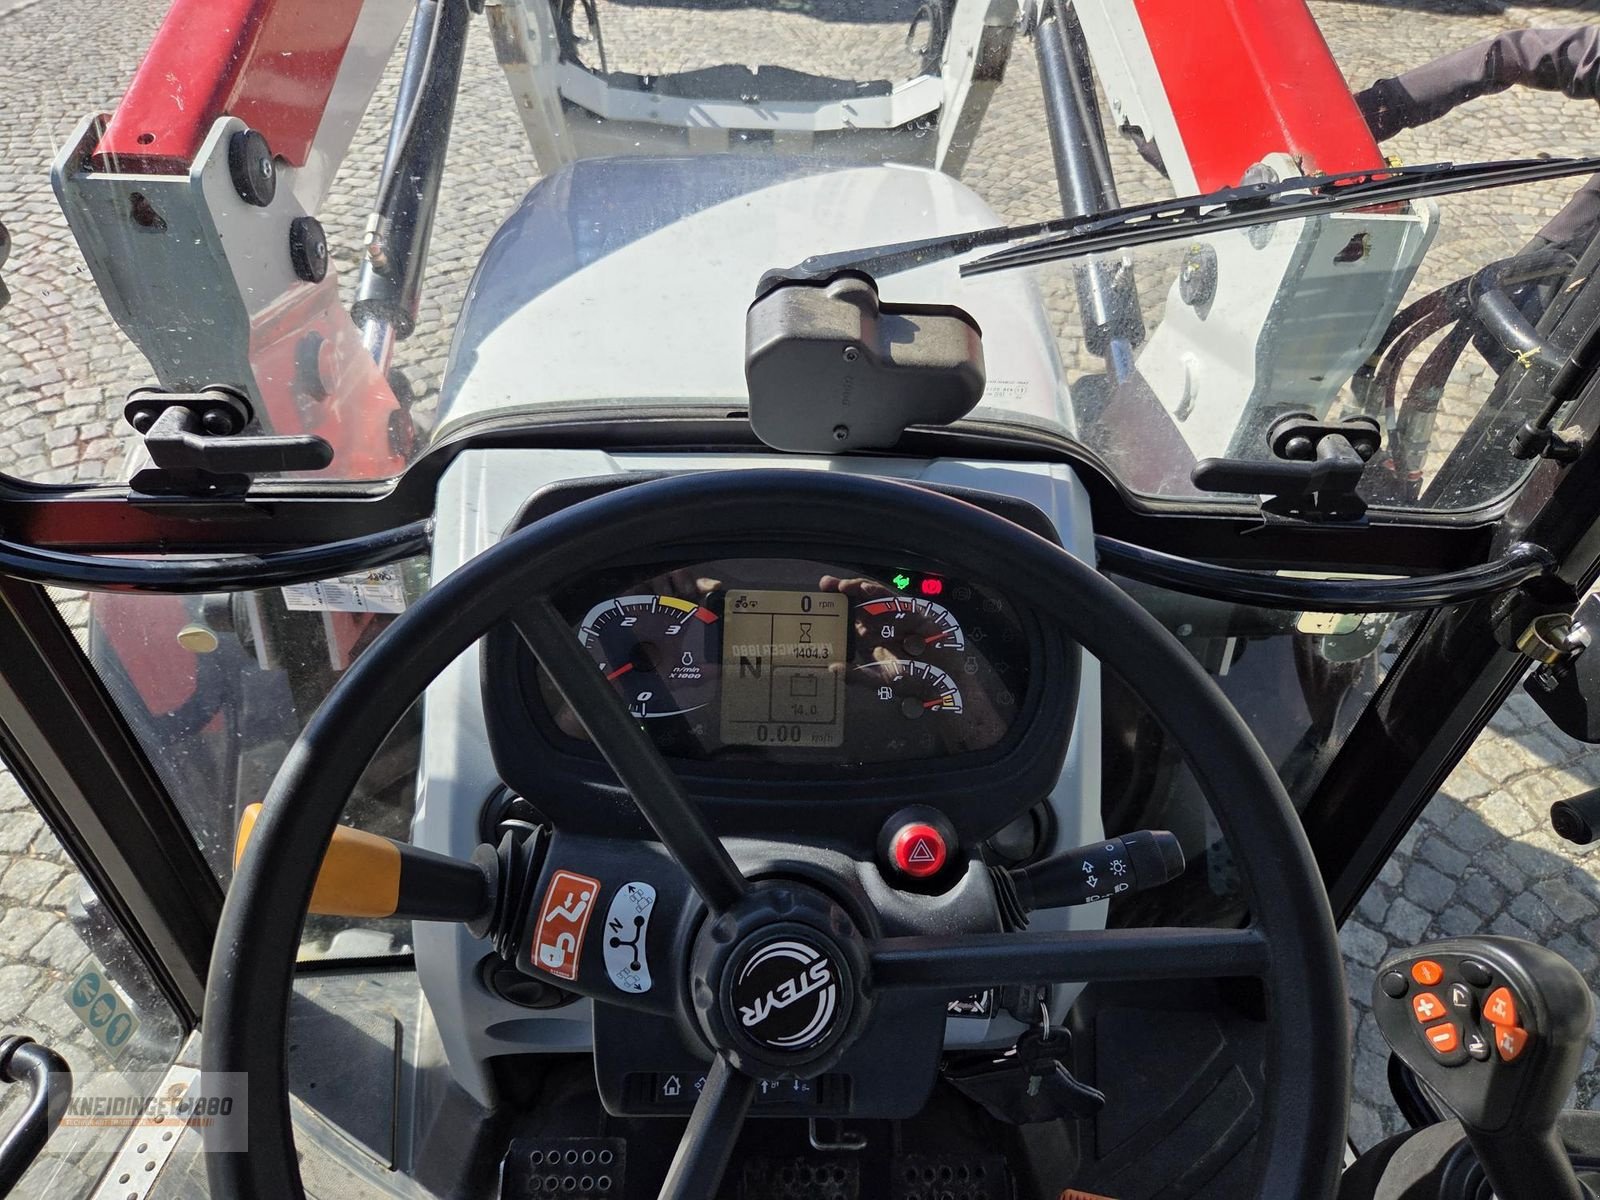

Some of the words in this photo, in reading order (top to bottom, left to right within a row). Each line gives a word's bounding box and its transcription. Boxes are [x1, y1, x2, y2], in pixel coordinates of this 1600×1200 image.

[800, 595, 812, 613] 0
[818, 600, 835, 609] rpm
[620, 617, 637, 626] 2
[665, 625, 681, 635] 3
[740, 656, 762, 679] N
[637, 691, 652, 701] 0
[791, 704, 817, 715] 14.0
[757, 725, 801, 742] 0.00
[608, 917, 623, 933] N
[739, 958, 831, 1027] STEYR
